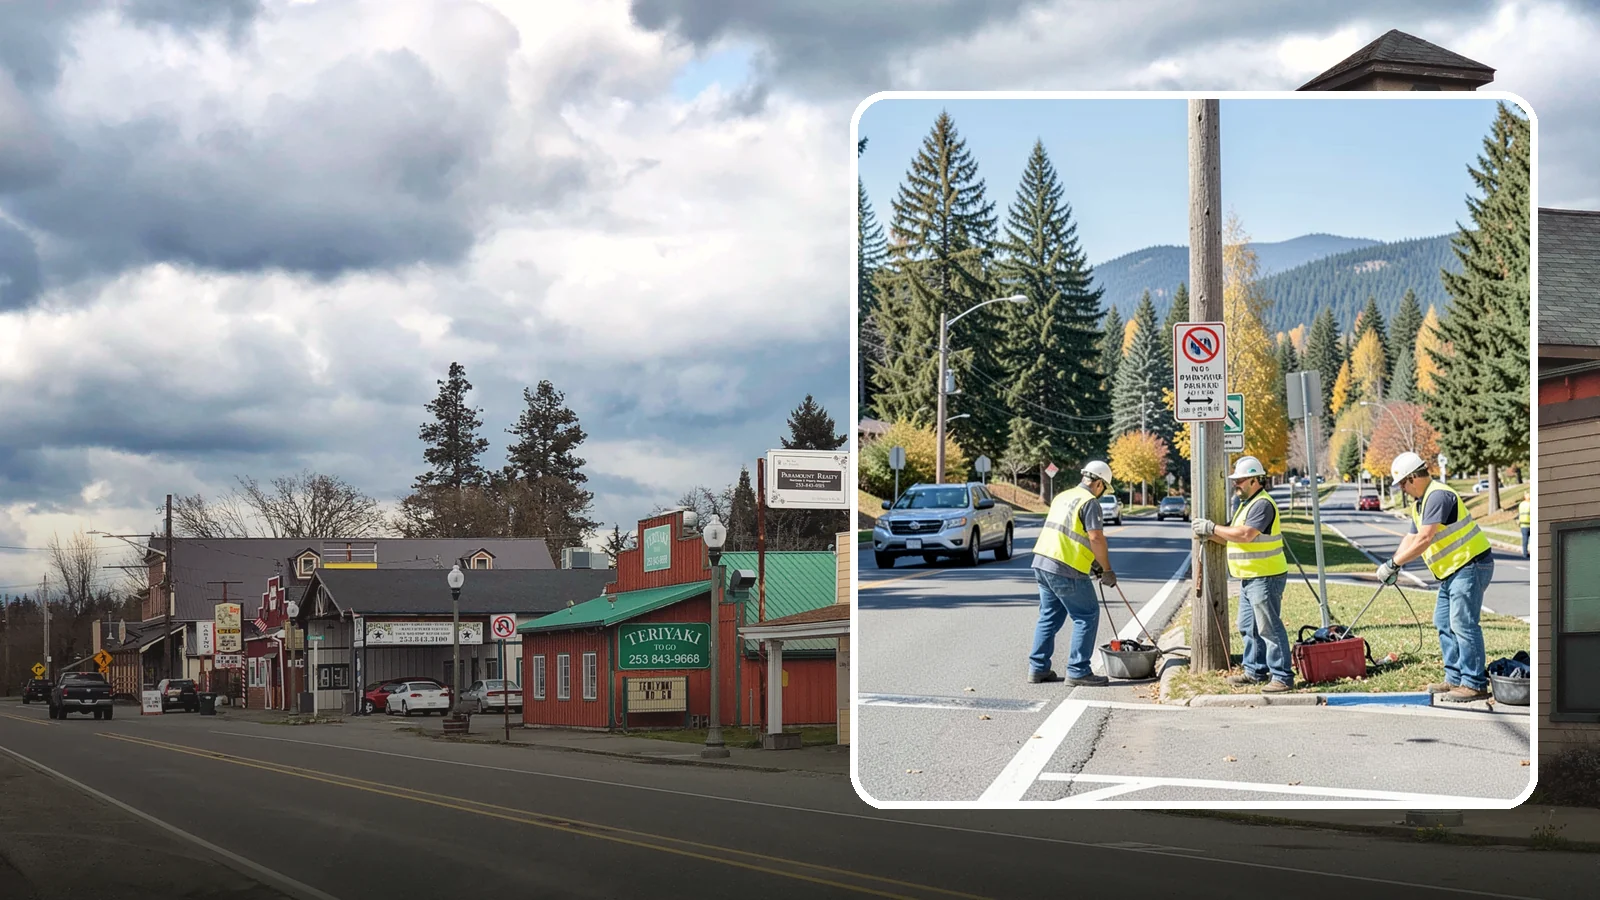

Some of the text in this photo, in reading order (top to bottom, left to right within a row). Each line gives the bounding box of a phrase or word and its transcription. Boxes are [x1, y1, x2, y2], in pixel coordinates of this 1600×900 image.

[625, 628, 702, 646] TERIYAKI
[629, 654, 700, 664] 253 843-9668
